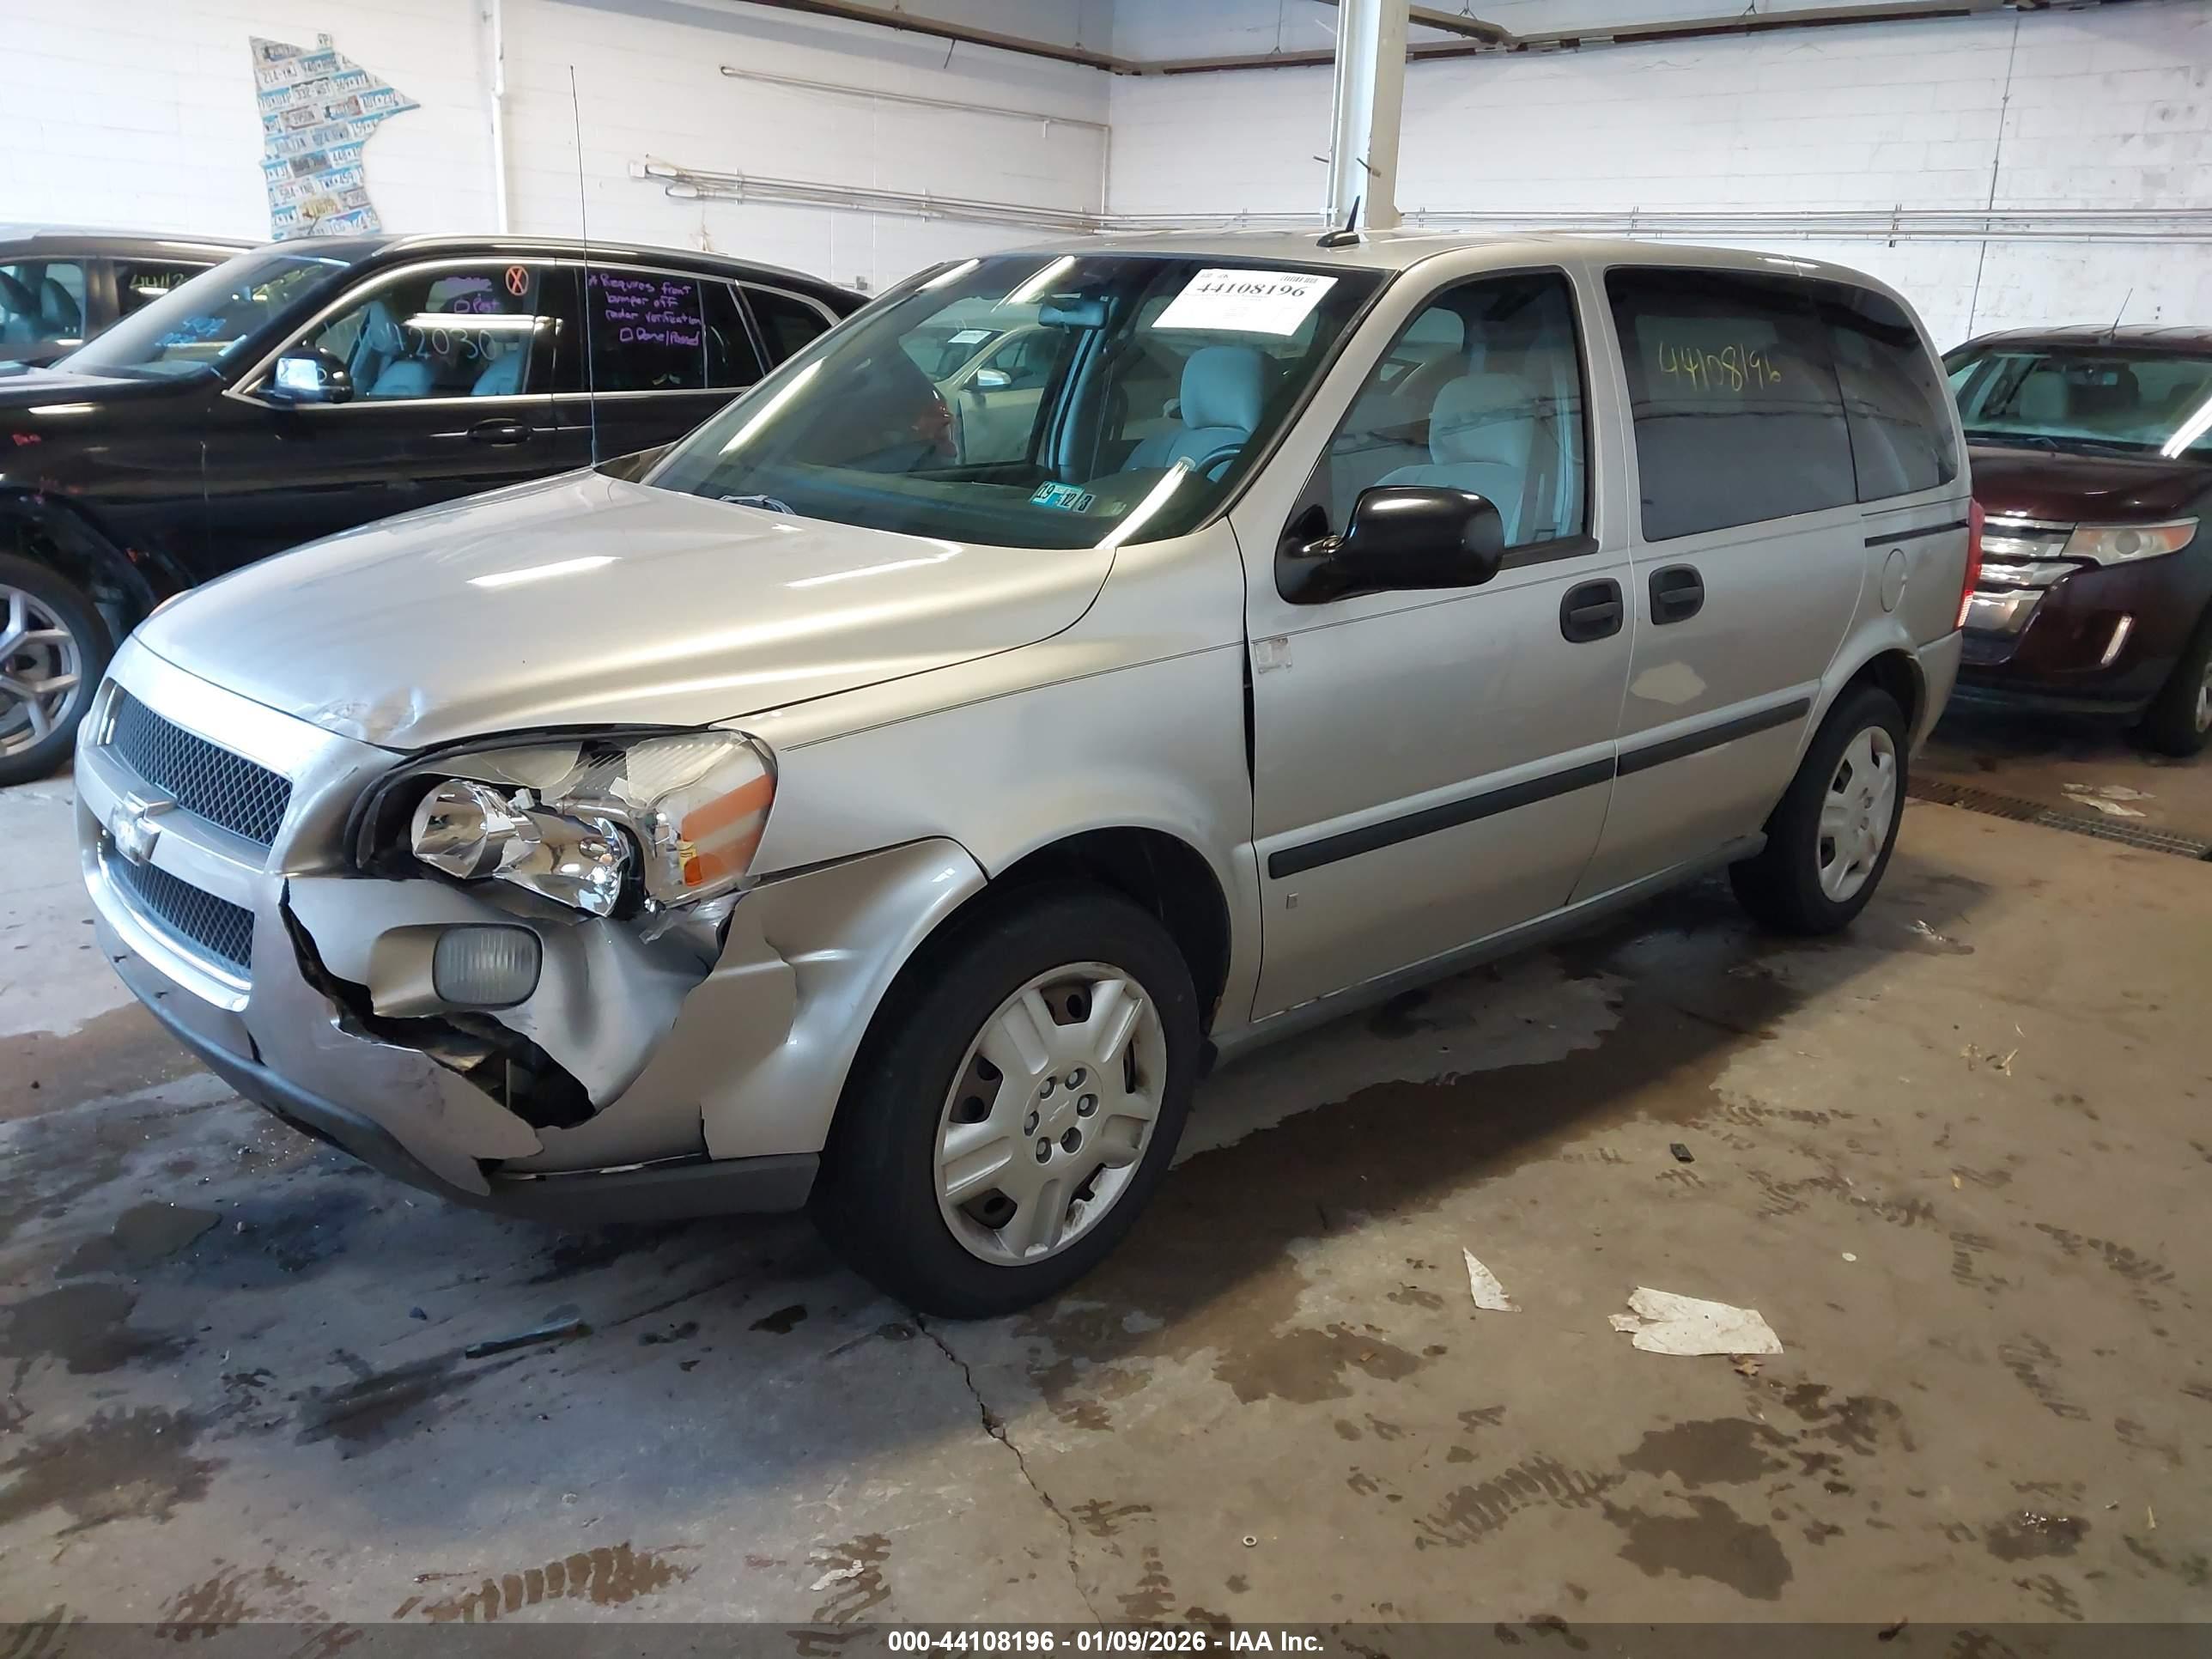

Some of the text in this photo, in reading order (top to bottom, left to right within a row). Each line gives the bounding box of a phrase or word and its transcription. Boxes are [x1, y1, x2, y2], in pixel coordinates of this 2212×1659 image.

[1196, 282, 1308, 297] 44108196
[1036, 483, 1055, 499] 19
[1060, 492, 1077, 507] 12
[1078, 495, 1092, 511] 3
